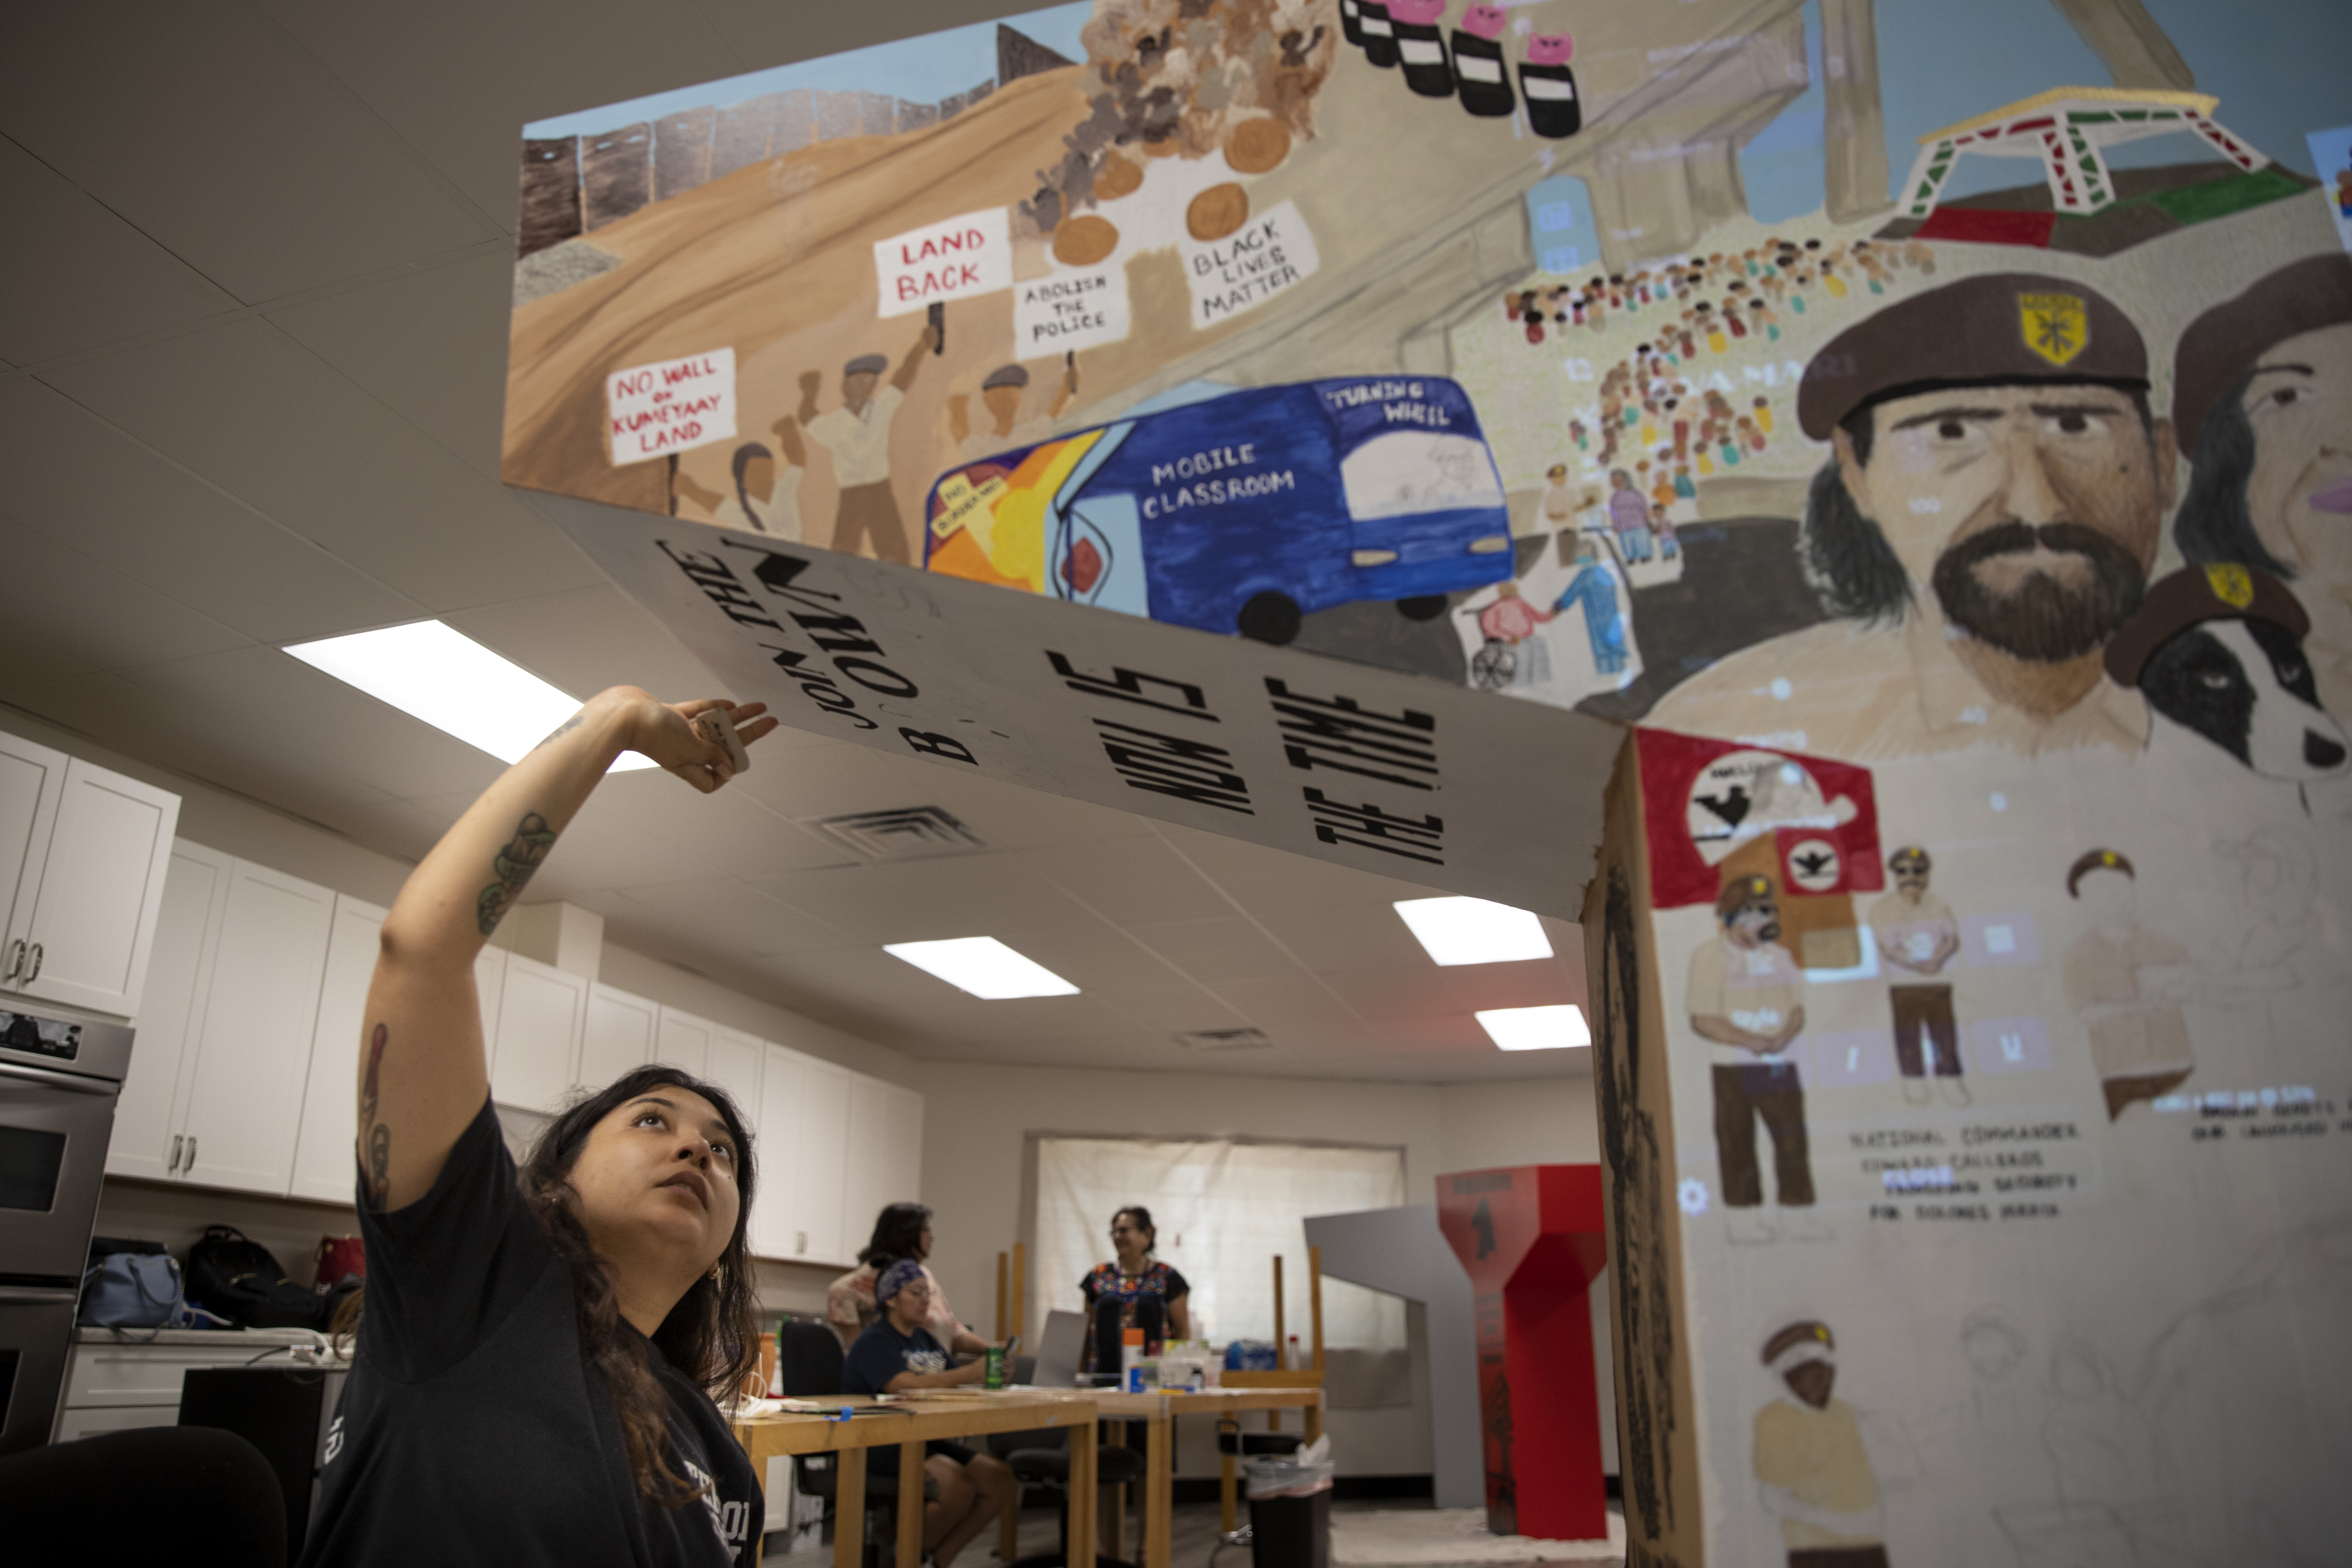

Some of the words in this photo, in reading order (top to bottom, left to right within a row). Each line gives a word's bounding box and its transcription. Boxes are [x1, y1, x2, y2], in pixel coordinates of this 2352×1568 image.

[902, 229, 984, 265] LAND
[1194, 220, 1280, 277] BLACK
[1223, 245, 1286, 284] LIVES
[897, 263, 980, 301] BACK
[1025, 276, 1106, 303] ABOLISH
[1203, 264, 1301, 319] MATTER
[1033, 312, 1105, 342] POLICE
[1053, 302, 1085, 317] THE
[617, 370, 653, 400] NO
[662, 358, 717, 385] WALL
[1326, 381, 1423, 409] TURNING
[1384, 402, 1450, 426] WHEEL
[640, 421, 702, 453] LAND
[1151, 443, 1257, 487] MOBILE
[1143, 470, 1295, 519] CLASSROOM
[655, 539, 786, 634] THE
[1262, 675, 1441, 791] TIME
[1092, 717, 1256, 816] NOW
[1302, 785, 1445, 866] THE
[1849, 1128, 1945, 1148] NATIONAL
[1961, 1122, 2079, 1146] COMMANDER
